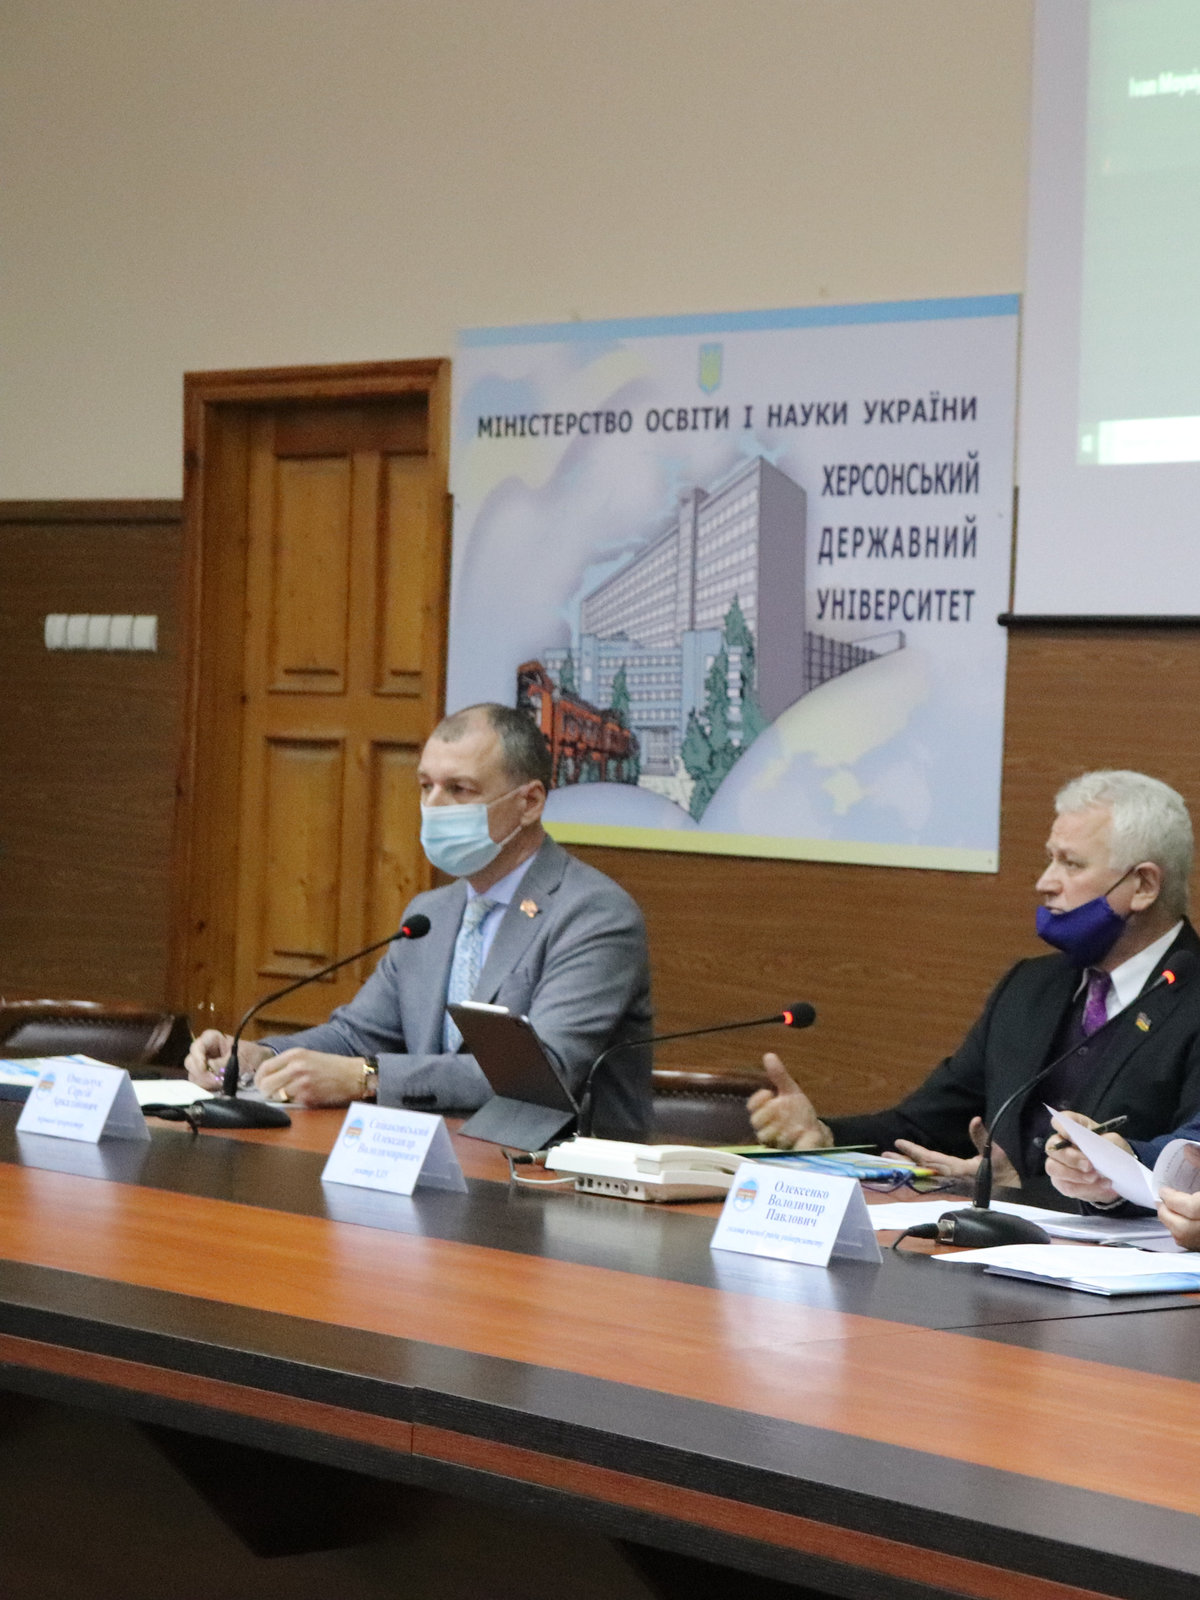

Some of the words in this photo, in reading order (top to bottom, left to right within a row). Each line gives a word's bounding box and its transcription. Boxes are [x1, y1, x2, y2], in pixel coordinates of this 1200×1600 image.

[477, 409, 634, 438] МІНІСТЕРСТВО
[645, 405, 730, 433] ОСВІТИ
[743, 404, 753, 429] І
[767, 400, 848, 429] НАУКИ
[863, 390, 978, 425] УКРАЇНИ
[821, 450, 980, 497] ХЕРСОНСЬКИЙ
[817, 514, 978, 566] ДЕРЖАВНИЙ
[816, 588, 976, 622] УНІВЕРСИТЕТ
[767, 1194, 826, 1217] Володимир
[774, 1180, 830, 1200] Олексенко
[765, 1208, 818, 1228] Павлович
